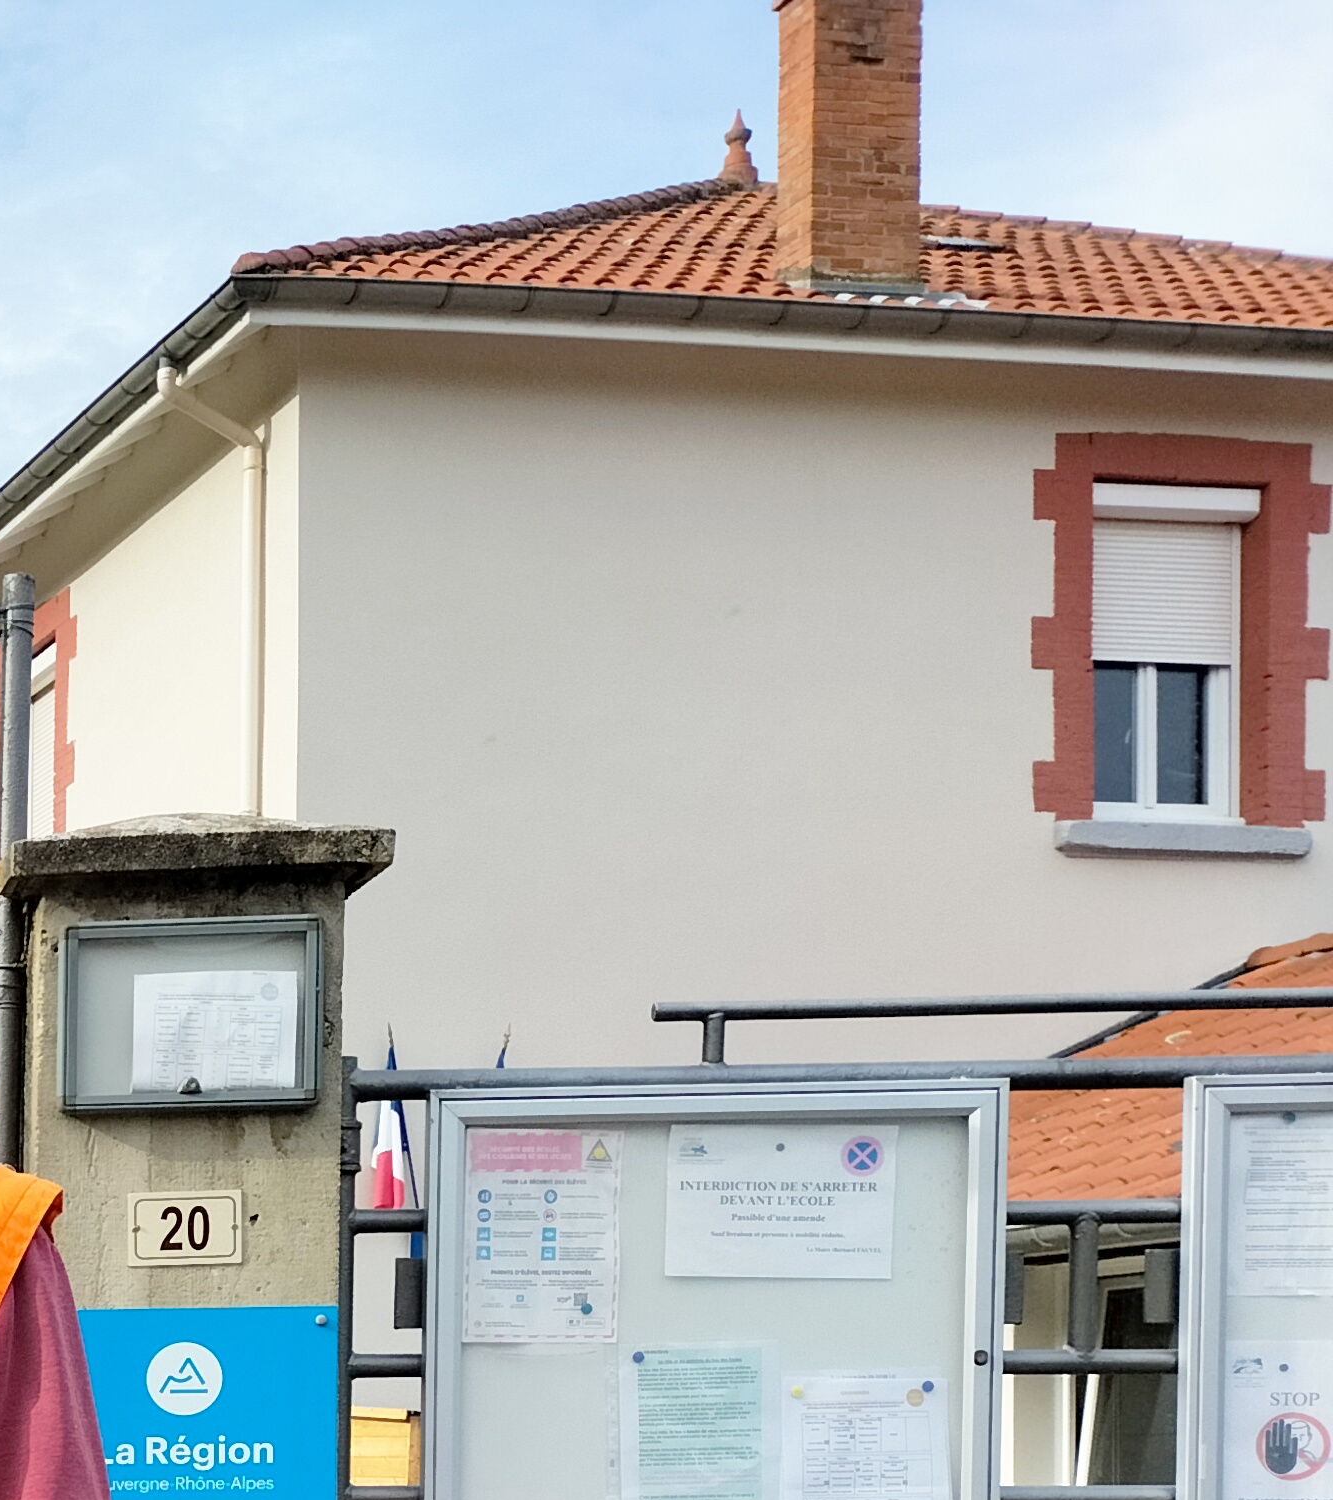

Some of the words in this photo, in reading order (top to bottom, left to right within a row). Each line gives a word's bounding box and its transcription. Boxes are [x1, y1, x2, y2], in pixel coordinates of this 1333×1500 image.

[679, 1180, 777, 1192] INTERDICTION
[780, 1181, 798, 1192] DE
[801, 1181, 878, 1193] S'ARRETER
[719, 1195, 774, 1206] DEVANT
[777, 1195, 836, 1207] L'ECOLE
[731, 1213, 765, 1223] Passible
[767, 1213, 792, 1222] d'une
[793, 1214, 826, 1222] amende
[159, 1205, 211, 1251] 20
[1269, 1391, 1320, 1407] STOP
[145, 1434, 274, 1472] Région
[109, 1475, 275, 1494] uvergne-Rhône-Alpes
